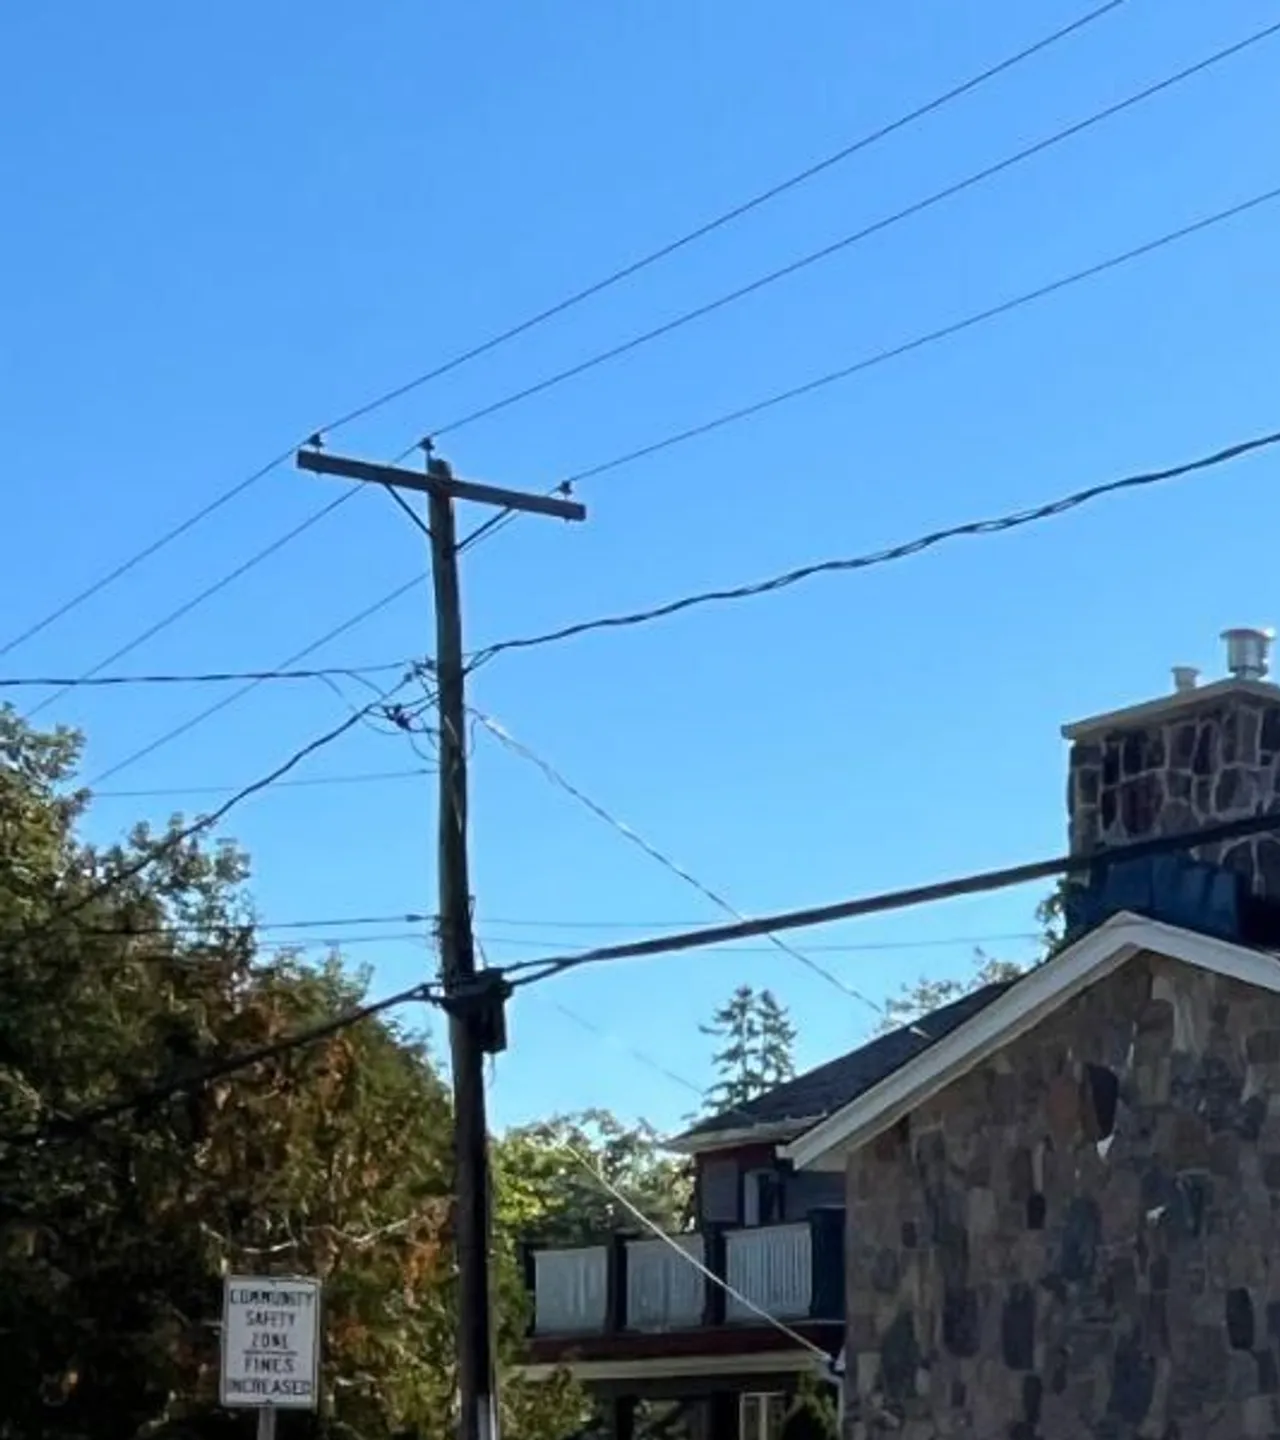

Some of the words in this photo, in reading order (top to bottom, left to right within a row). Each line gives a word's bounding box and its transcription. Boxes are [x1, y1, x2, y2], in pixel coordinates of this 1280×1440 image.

[230, 1289, 314, 1306] COMMUNITY
[245, 1309, 296, 1327] SAFETY
[251, 1332, 289, 1350] ZONE
[244, 1357, 295, 1374] FINES
[228, 1379, 312, 1396] INCREASED
